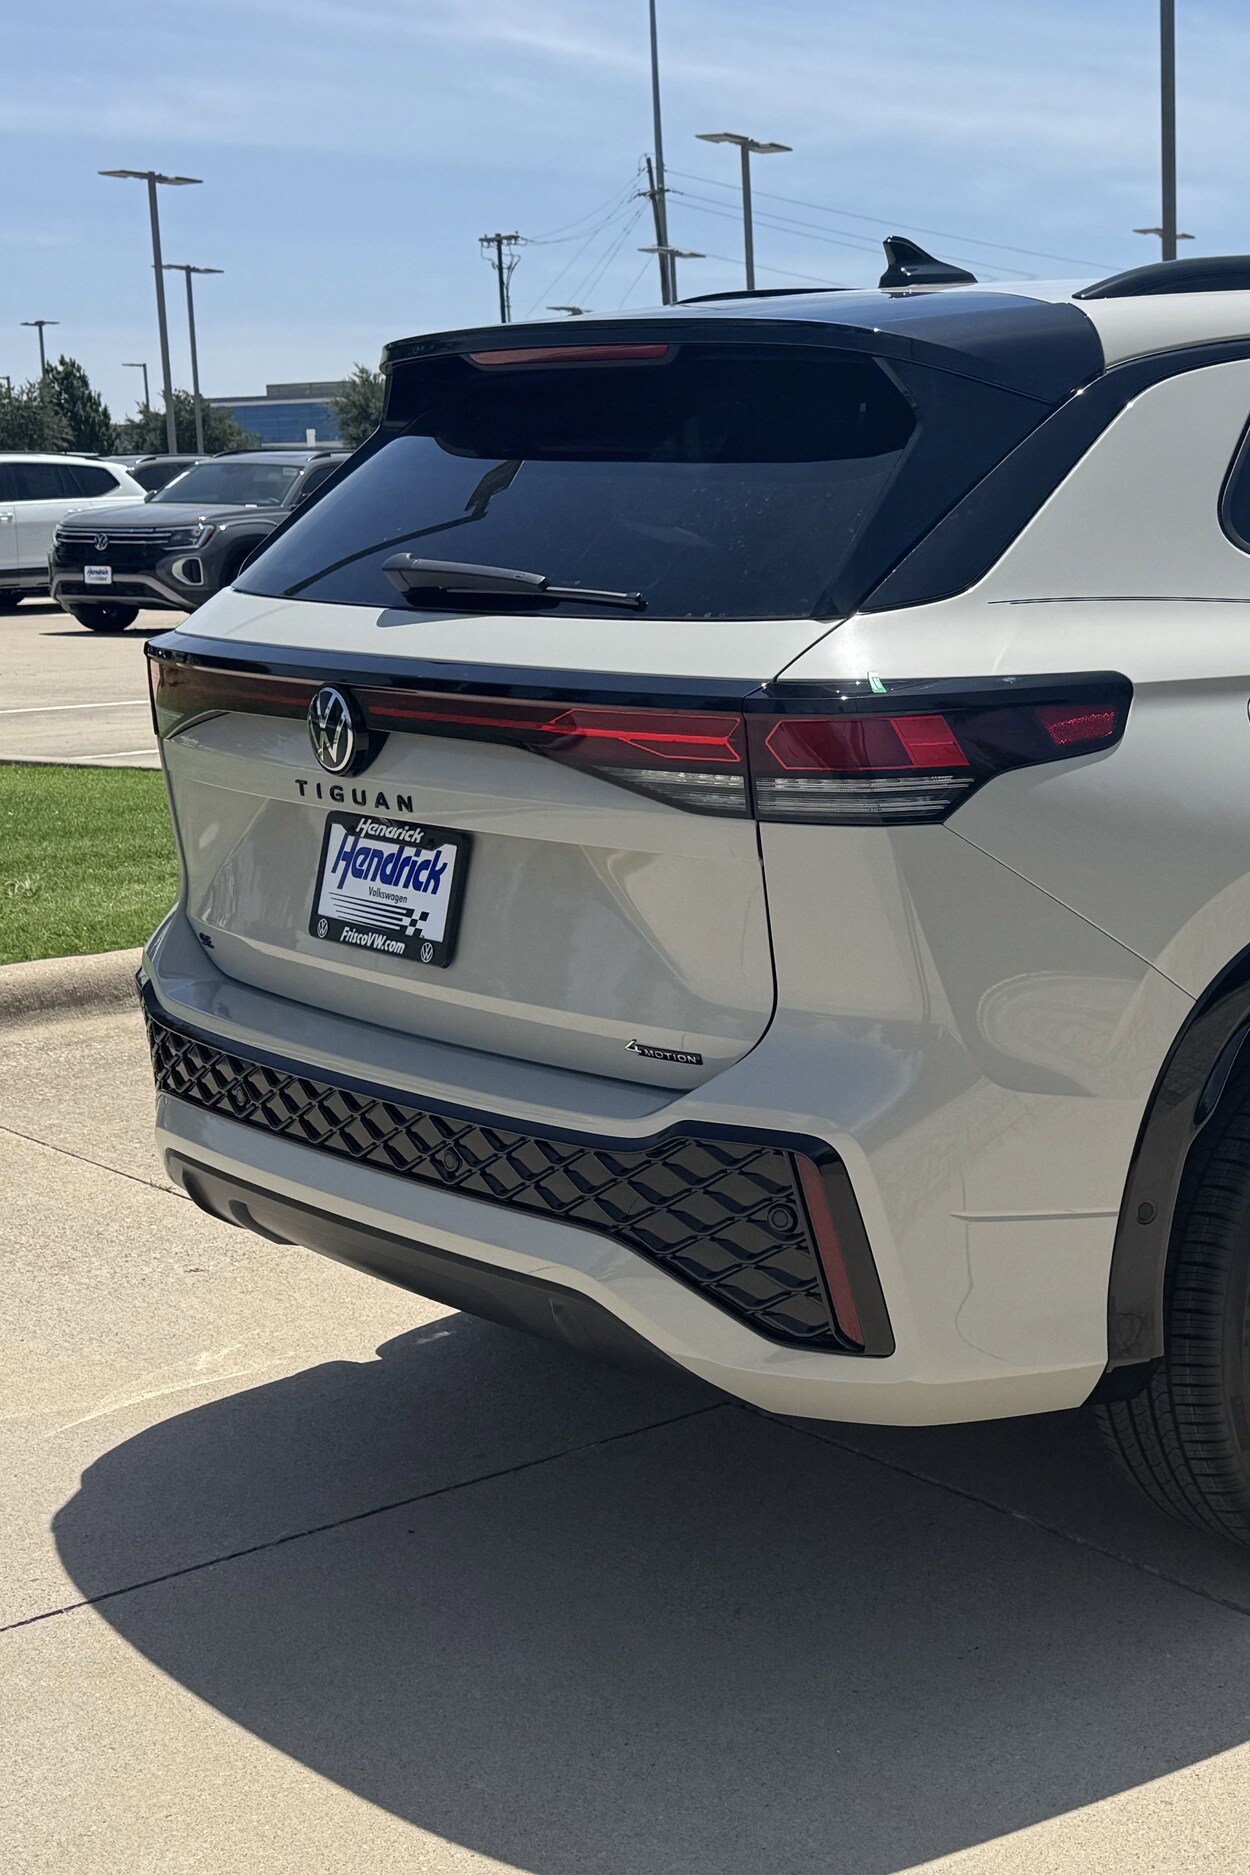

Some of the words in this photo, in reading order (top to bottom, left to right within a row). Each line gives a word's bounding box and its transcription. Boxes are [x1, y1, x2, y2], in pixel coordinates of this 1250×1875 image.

[295, 779, 413, 812] TIGUAN
[356, 818, 424, 843] Hendrick
[331, 833, 448, 895] Hendrick
[368, 886, 408, 904] Volkswagen
[340, 926, 406, 955] FriscoVW.com
[624, 1040, 697, 1064] 4MOTION
